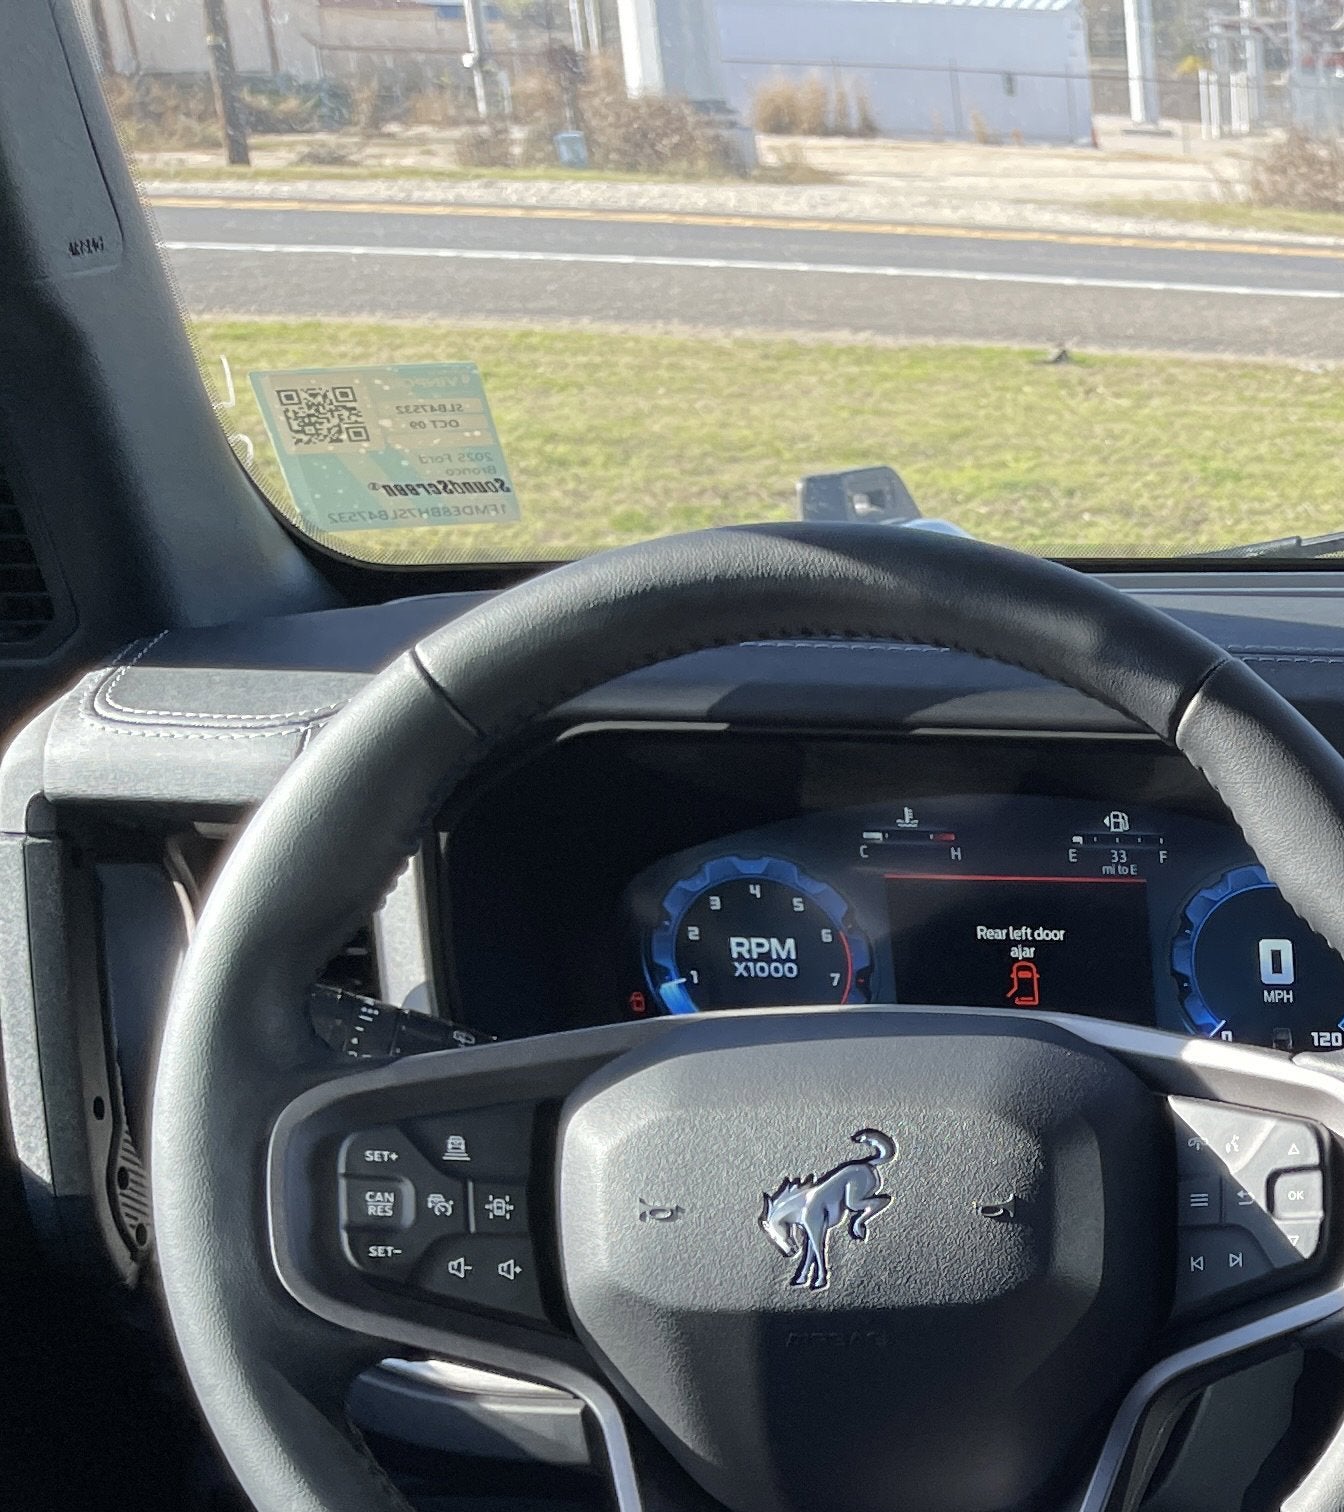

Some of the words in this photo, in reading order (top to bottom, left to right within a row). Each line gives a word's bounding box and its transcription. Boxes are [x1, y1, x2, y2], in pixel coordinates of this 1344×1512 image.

[860, 845, 869, 858] C
[950, 847, 962, 861] H
[1069, 849, 1077, 863] E
[1111, 850, 1127, 863] 33
[1160, 851, 1167, 864] F
[1102, 864, 1116, 875] mi
[1118, 865, 1129, 875] to
[1130, 865, 1137, 876] E
[750, 884, 761, 899] 4
[710, 896, 721, 911] 3
[792, 898, 805, 912] 5
[688, 926, 700, 941] 2
[821, 929, 833, 943] 6
[976, 926, 1007, 941] Rear
[1009, 926, 1032, 941] left
[1034, 927, 1065, 941] door
[729, 936, 797, 960] RPM
[1010, 945, 1035, 960] ajar
[1258, 938, 1295, 985] 0
[690, 970, 699, 984] 1
[734, 962, 798, 978] X1000
[830, 973, 841, 987] 7
[1264, 990, 1294, 1003] MPH
[1310, 1032, 1343, 1047] 120
[364, 1150, 399, 1162] SET+
[365, 1192, 395, 1203] CAN
[1288, 1190, 1304, 1202] OK
[368, 1206, 393, 1217] RES
[368, 1246, 402, 1258] SET-
